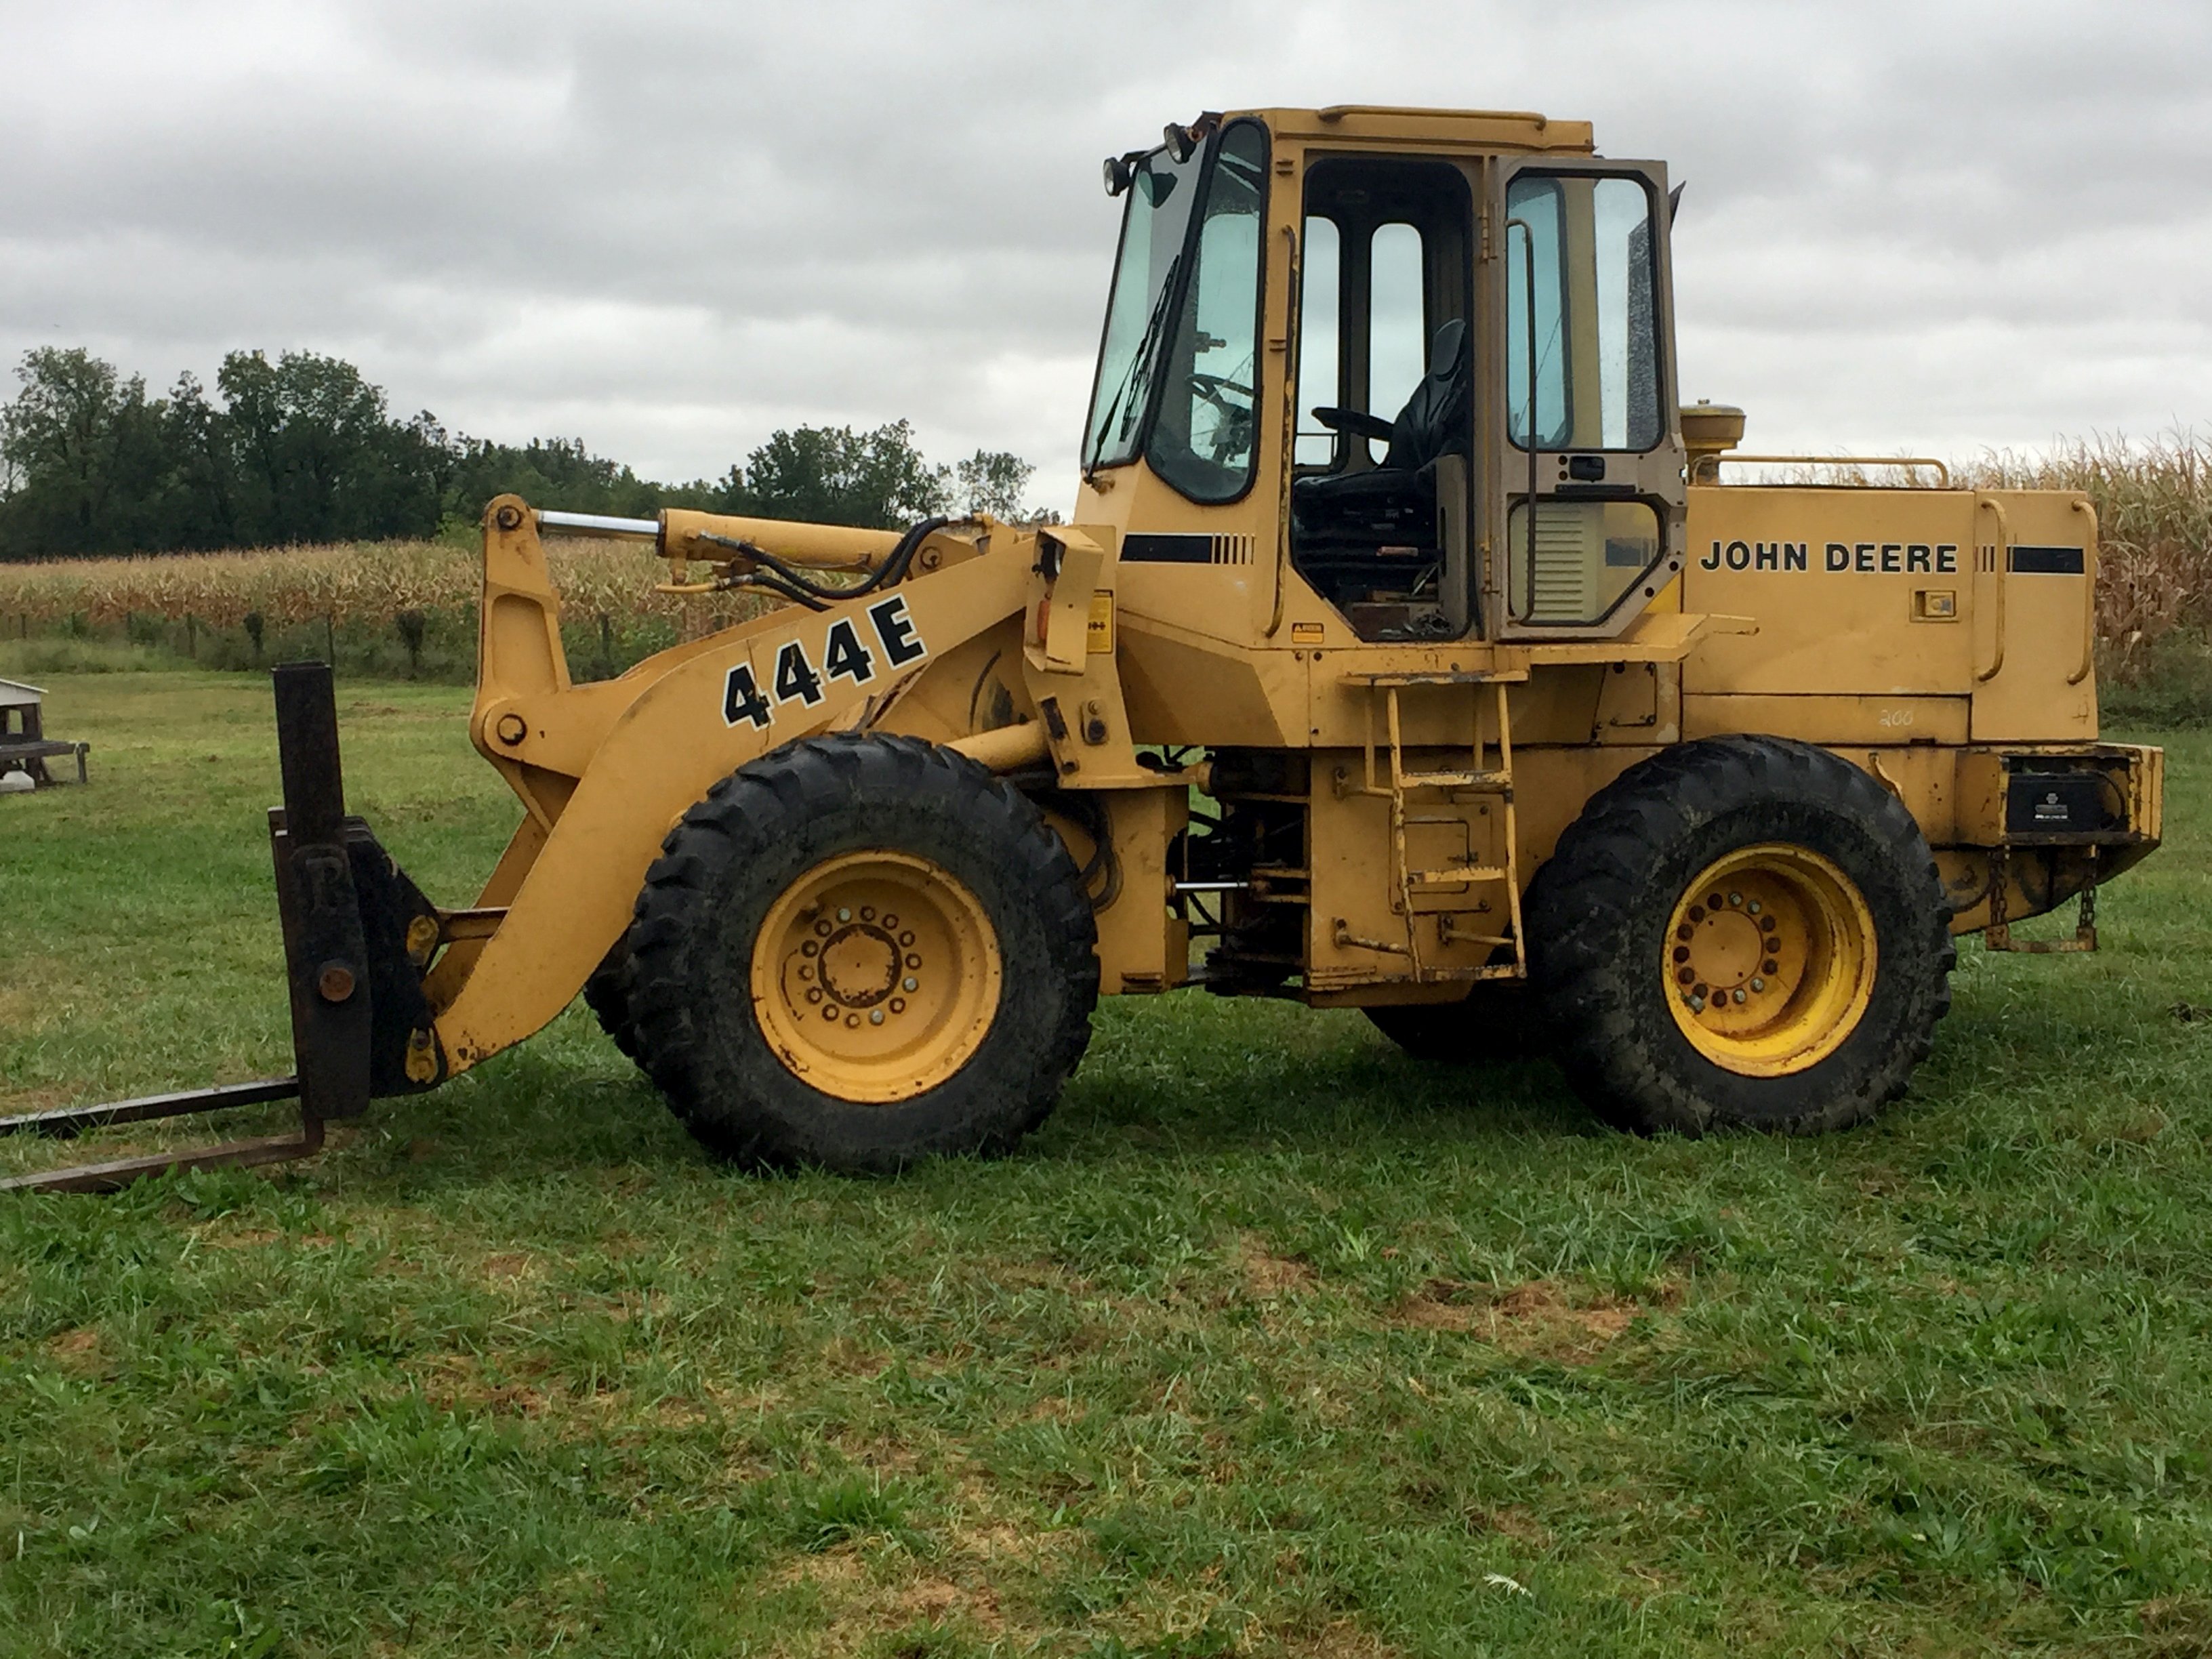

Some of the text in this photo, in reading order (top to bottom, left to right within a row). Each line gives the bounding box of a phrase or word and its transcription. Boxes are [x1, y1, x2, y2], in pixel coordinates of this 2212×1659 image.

[1700, 541, 1958, 573] JOHN DEERE
[723, 594, 926, 730] 444E
[1879, 709, 1914, 727] 200
